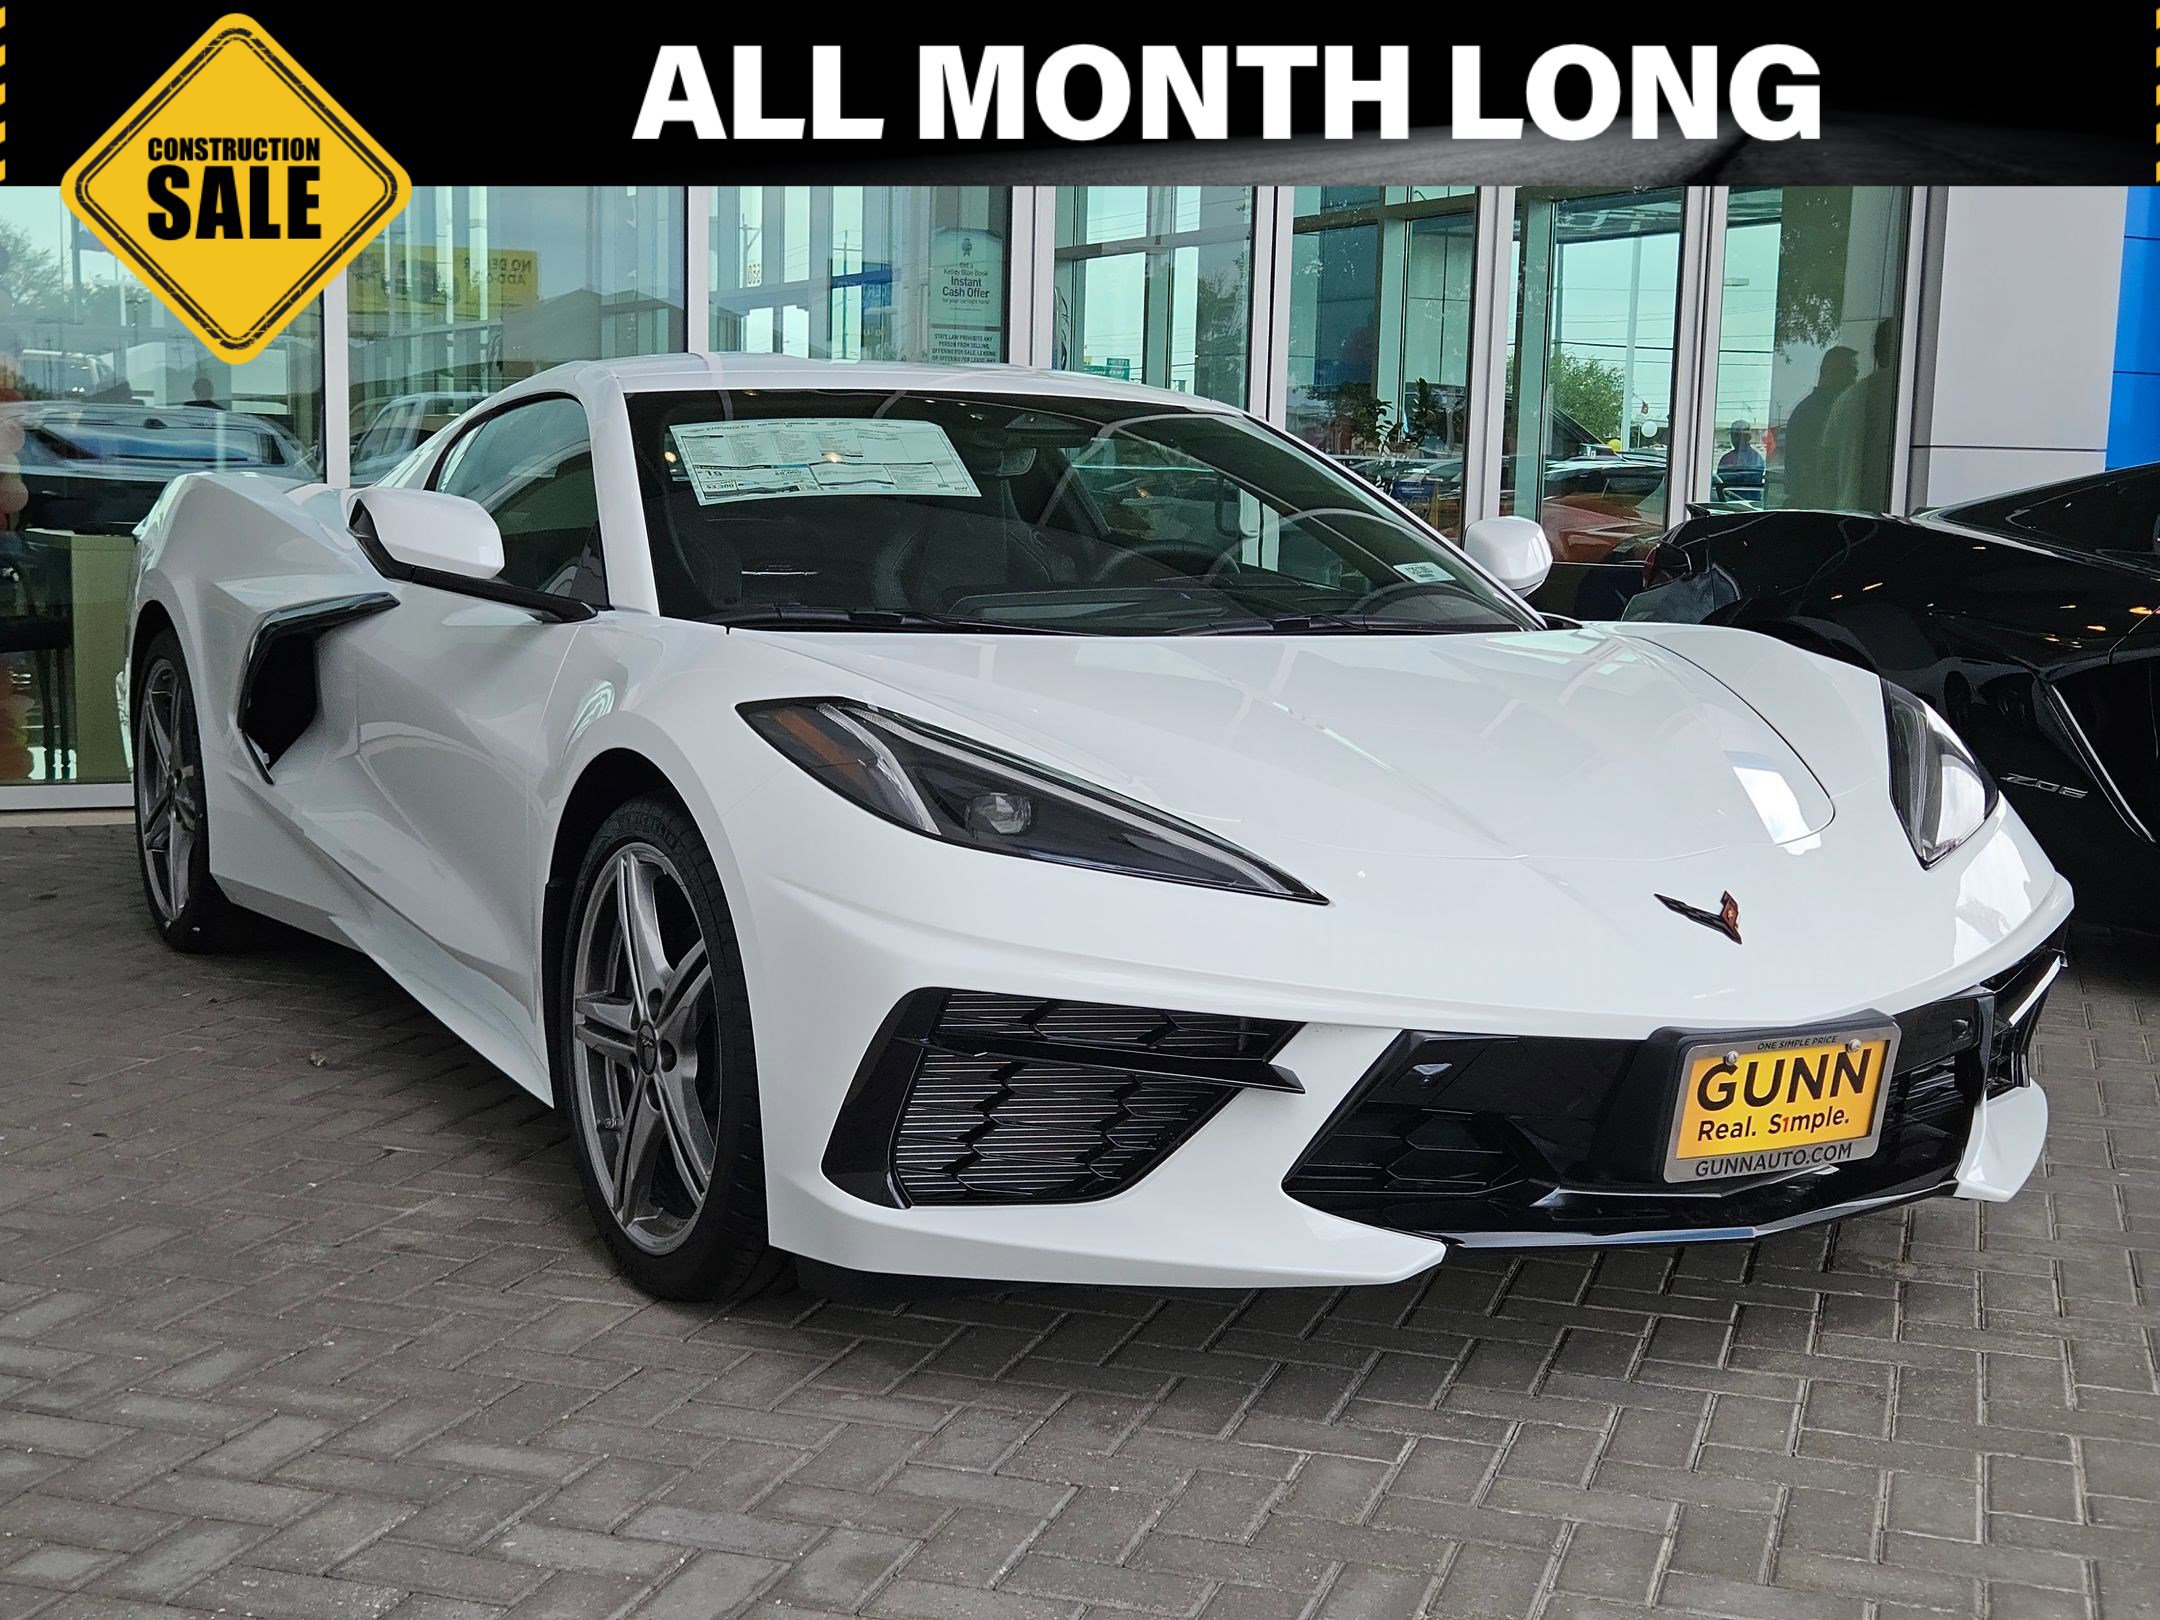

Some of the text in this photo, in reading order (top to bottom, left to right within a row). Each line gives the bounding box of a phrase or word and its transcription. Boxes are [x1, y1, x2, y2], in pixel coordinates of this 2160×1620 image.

[942, 286, 990, 298] Cash Offer
[951, 276, 982, 287] Instant
[1757, 1035, 1838, 1051] ONE SIMPLE PRICE
[1696, 1048, 1872, 1112] GUNN
[1697, 1116, 1757, 1142] Real.
[1695, 1142, 1853, 1177] GUNNAUTO.COM
